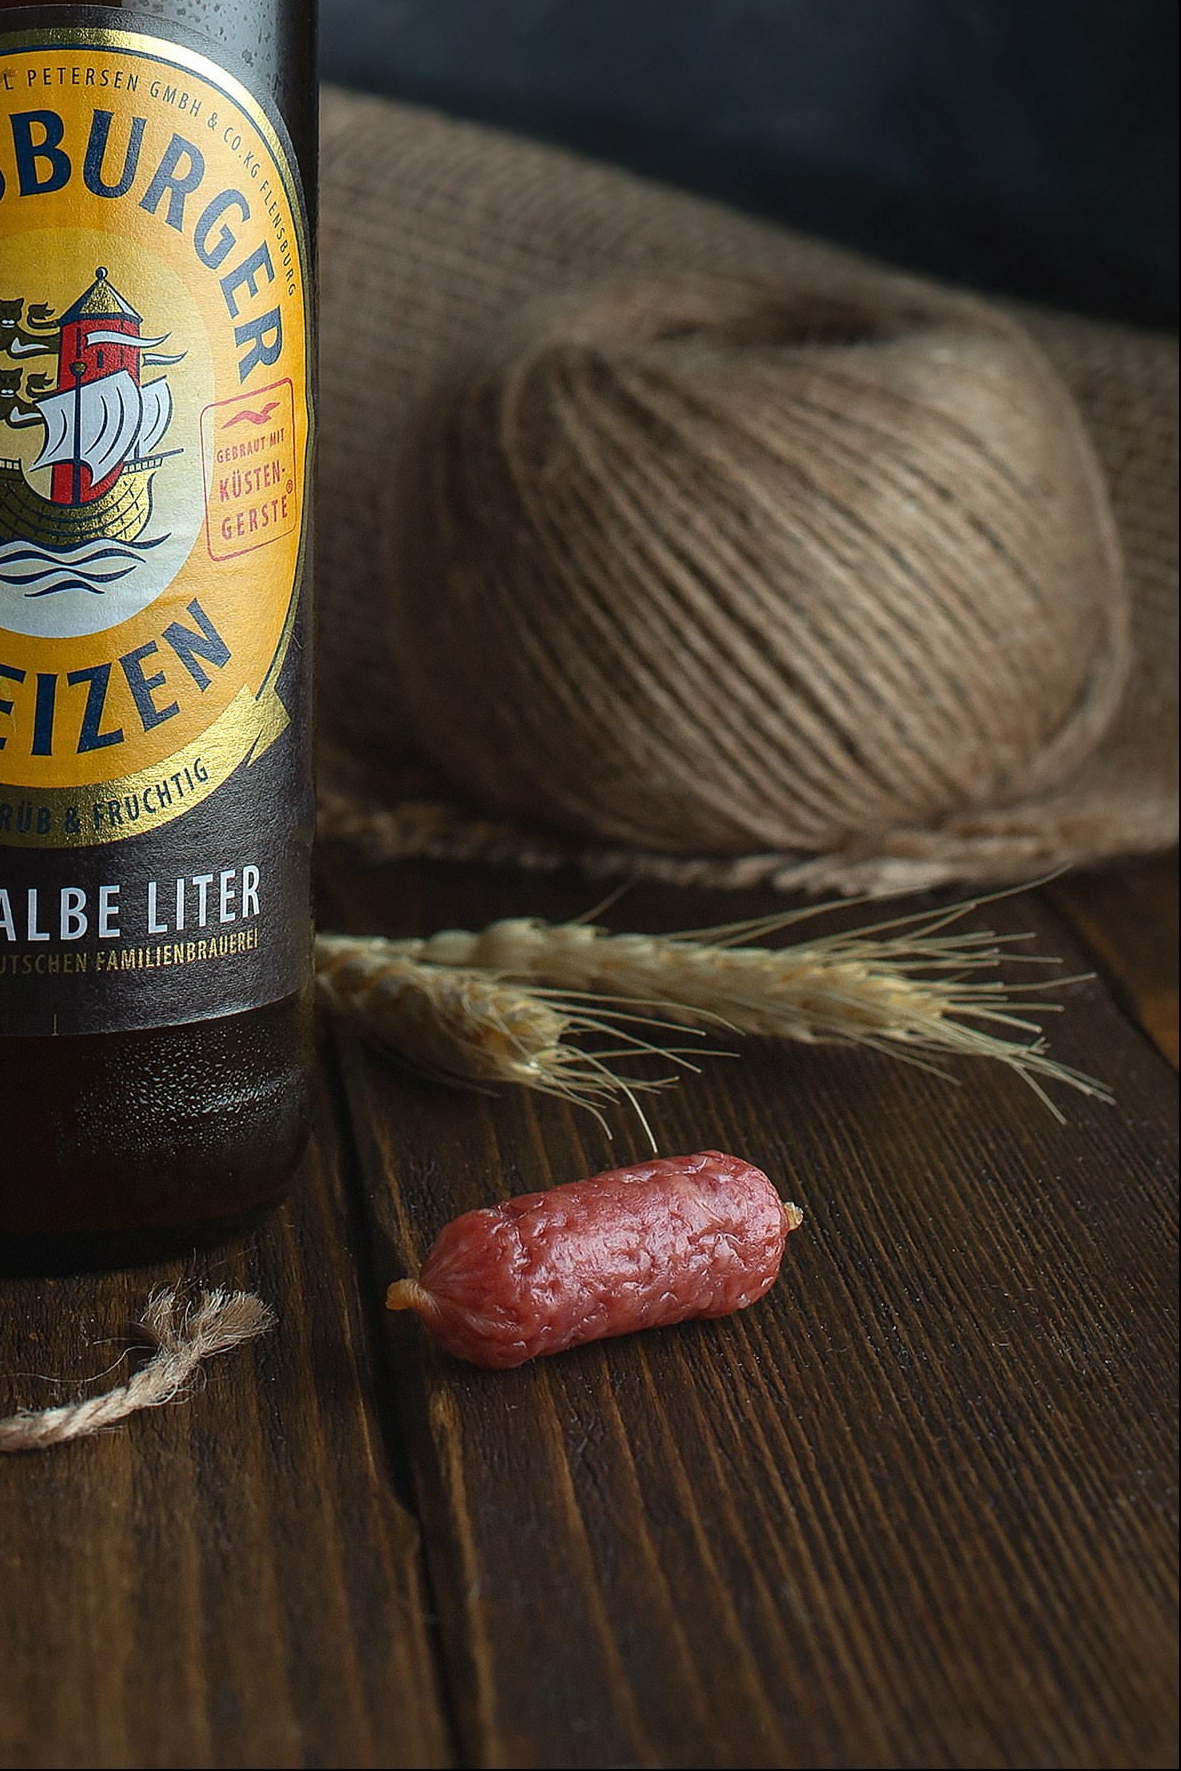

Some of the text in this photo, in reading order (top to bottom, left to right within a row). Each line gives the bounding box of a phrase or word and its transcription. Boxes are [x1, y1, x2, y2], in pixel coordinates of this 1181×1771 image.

[26, 66, 140, 93] PETERSEN
[149, 80, 203, 118] GMBH
[207, 111, 220, 131] &
[259, 179, 297, 297] FLENSBURG
[216, 427, 285, 464] GEBRAUT MIT
[219, 459, 286, 503] KÜSTEN-
[63, 805, 82, 834] &
[92, 756, 210, 831] FRUCHTIG
[147, 864, 262, 934] LITER
[96, 927, 260, 973] FAMILIENBRAUEREI
